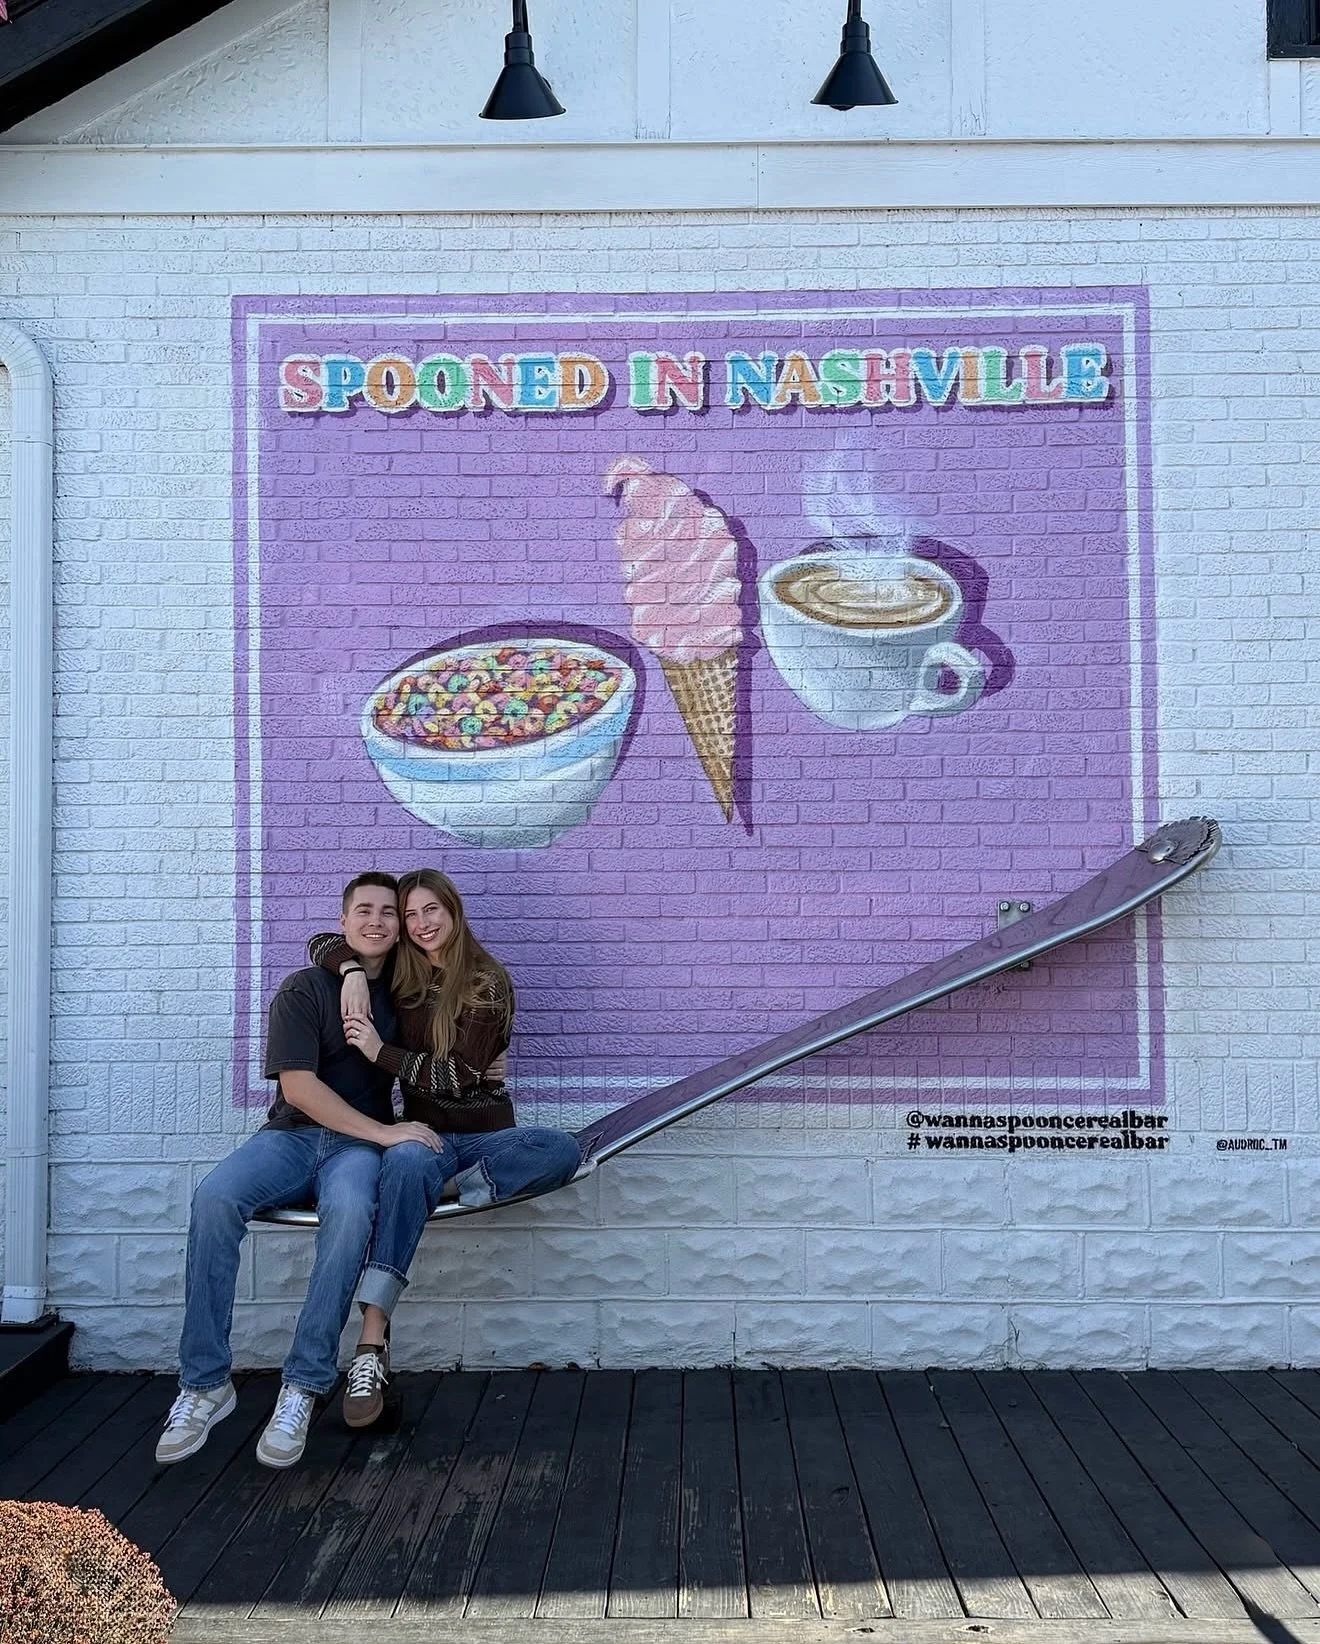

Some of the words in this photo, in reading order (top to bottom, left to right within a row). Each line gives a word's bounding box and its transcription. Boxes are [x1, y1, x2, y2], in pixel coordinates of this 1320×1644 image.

[279, 353, 610, 412] SPOONED
[628, 351, 705, 412] IN
[725, 343, 1110, 411] NASHVILLE
[906, 1110, 1168, 1134] @wannaspooncerealbar
